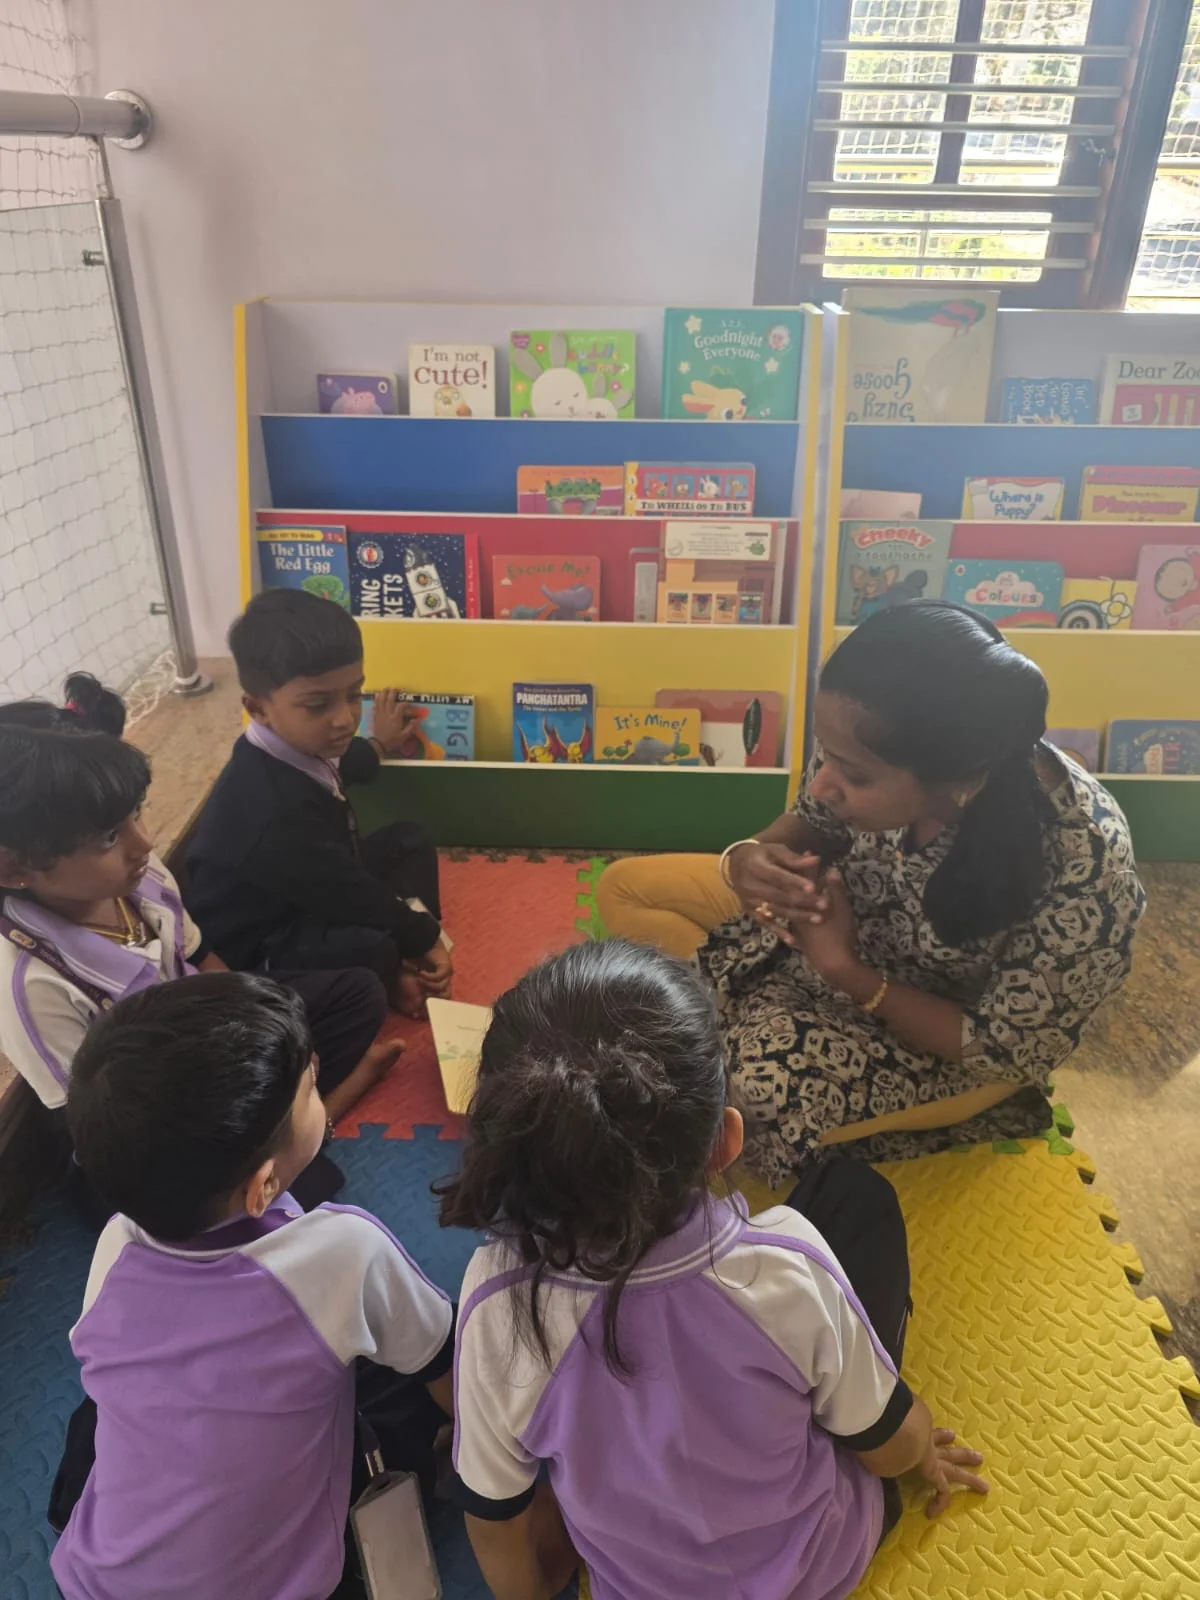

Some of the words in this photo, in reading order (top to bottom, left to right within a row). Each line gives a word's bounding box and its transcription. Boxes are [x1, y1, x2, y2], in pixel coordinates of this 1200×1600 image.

[694, 329, 763, 349] Goodnight
[423, 347, 449, 362] I'm
[455, 352, 481, 363] not
[702, 346, 762, 361] Everyone
[1119, 360, 1167, 379] Dear
[990, 490, 1031, 503] Where
[269, 543, 295, 556] The
[297, 543, 335, 557] Little
[274, 557, 302, 570] Red
[304, 558, 331, 574] Egg
[975, 588, 1037, 604] Colours
[516, 691, 588, 705] PANCHATANTRA
[446, 708, 470, 747] BIG
[613, 713, 640, 731] It's
[644, 713, 688, 732] Mine!
